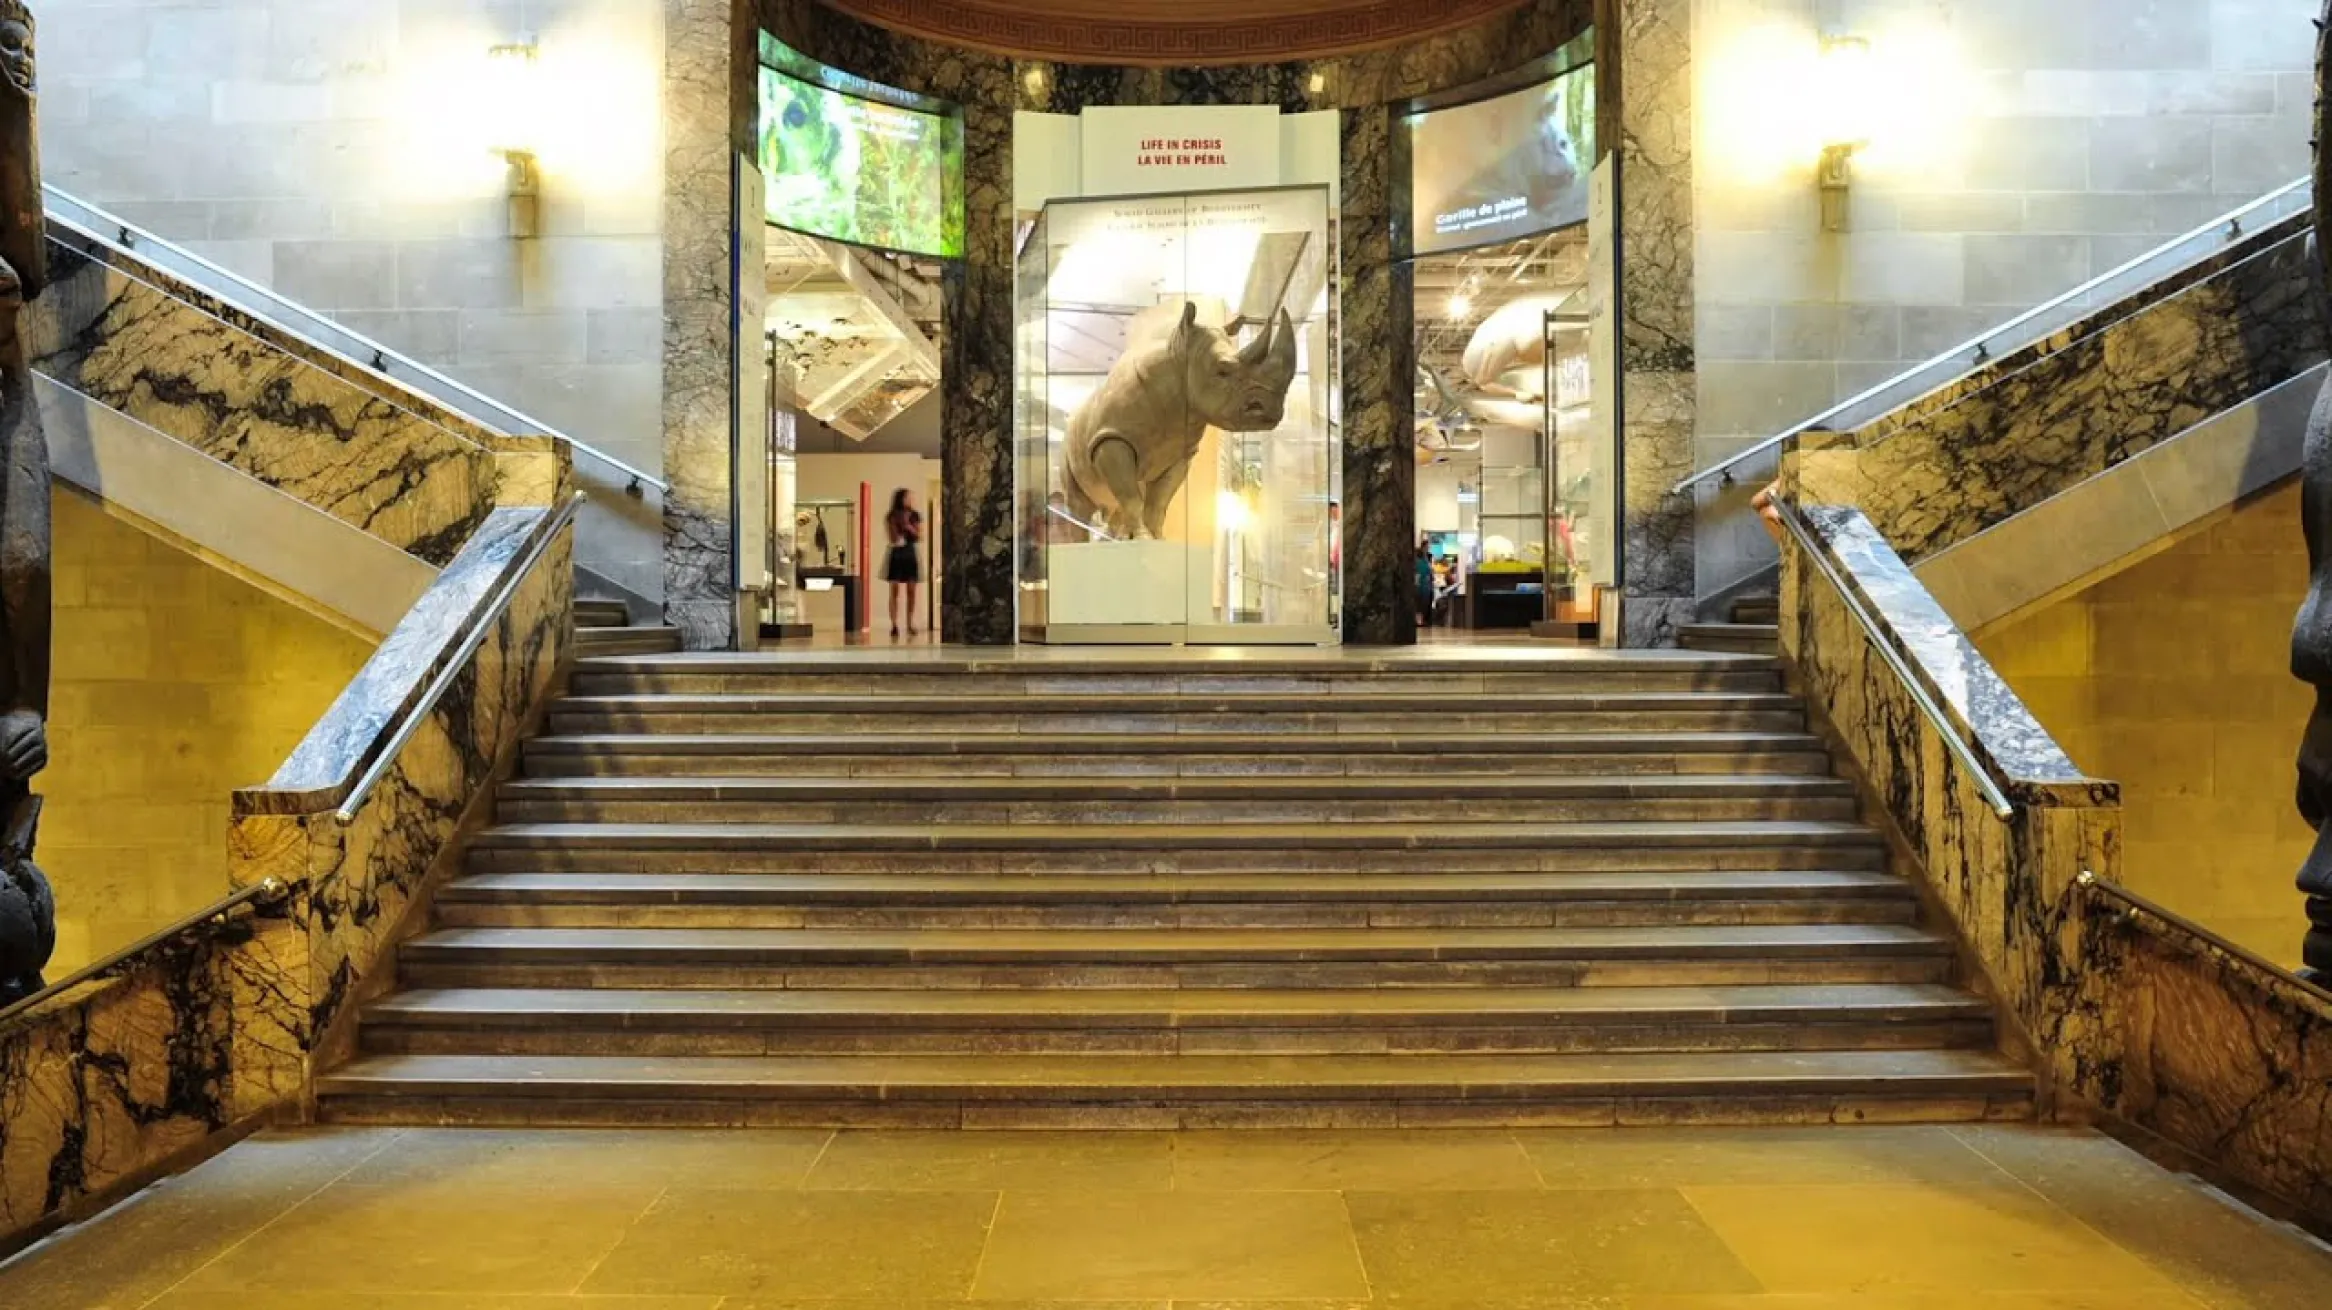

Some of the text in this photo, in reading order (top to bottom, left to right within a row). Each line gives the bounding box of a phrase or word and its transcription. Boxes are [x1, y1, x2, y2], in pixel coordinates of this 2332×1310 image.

[1141, 138, 1222, 150] LIFE IN CRISIS
[1138, 152, 1227, 165] LA VIE EN PÉRIL
